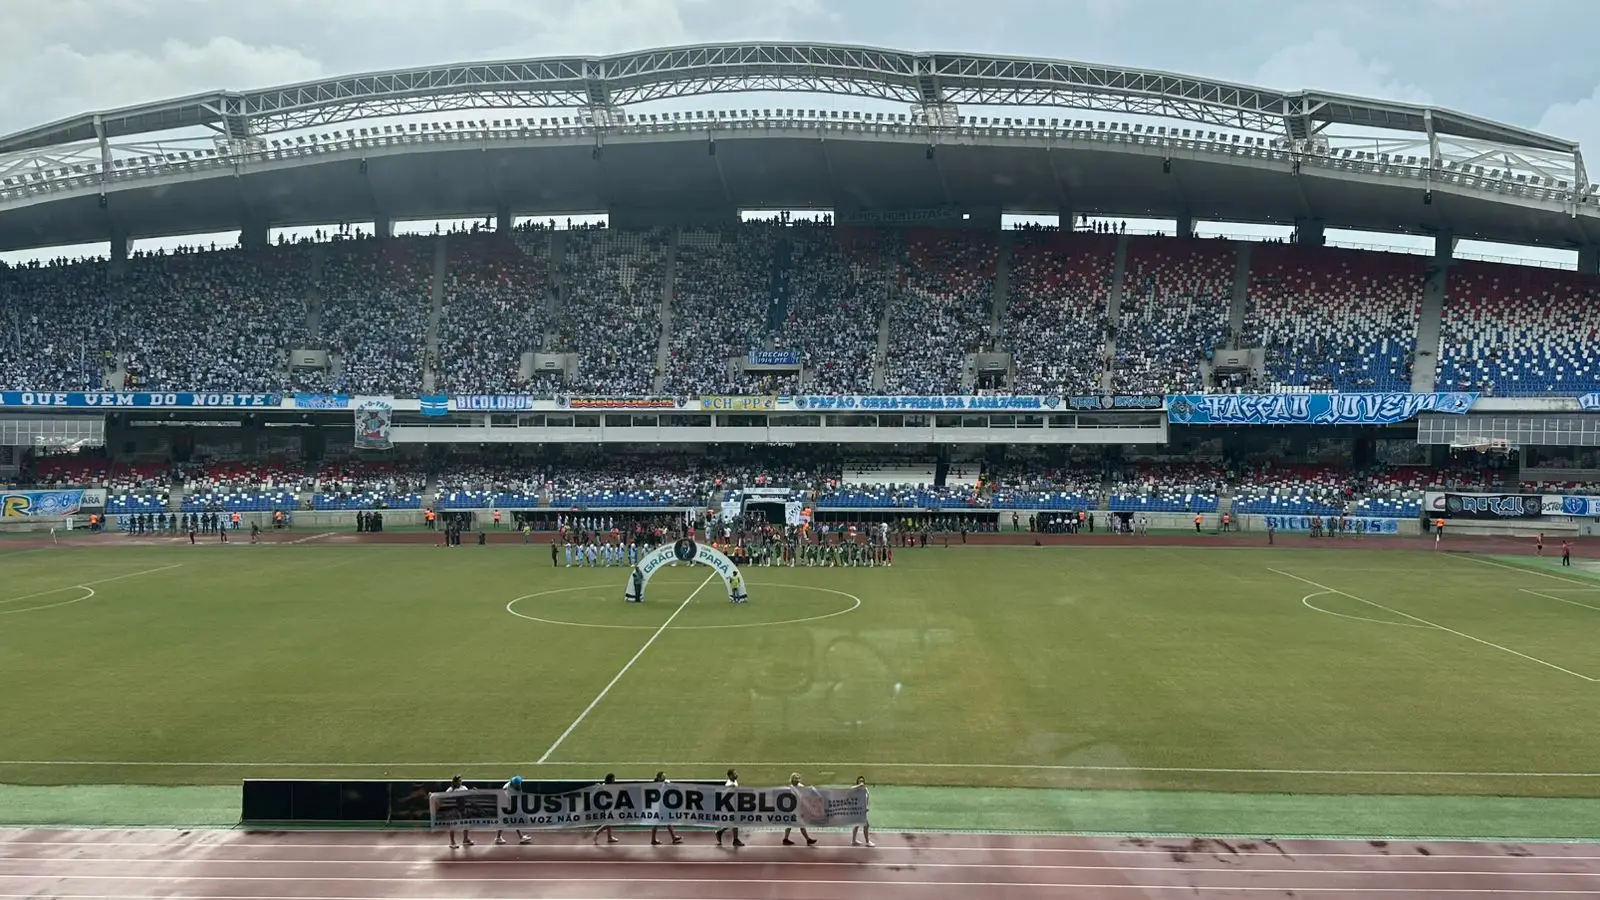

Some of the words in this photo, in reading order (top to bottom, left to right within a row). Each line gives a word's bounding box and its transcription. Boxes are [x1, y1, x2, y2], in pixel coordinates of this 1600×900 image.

[22, 393, 67, 405] QUE
[84, 393, 135, 406] VEM
[150, 394, 177, 405] DO
[192, 394, 266, 406] NORTE
[456, 395, 533, 409] BICOLOBOS
[1313, 393, 1437, 423] JOVEM
[644, 788, 704, 811] POR
[714, 791, 798, 813] KBLO
[502, 817, 525, 825] SUA
[529, 816, 552, 824] VOZ
[557, 812, 580, 823] NÃO
[618, 811, 664, 820] CALADA,
[668, 811, 735, 821] LUTAREMOS
[740, 814, 762, 822] POR
[767, 813, 797, 822] VOCÊ
